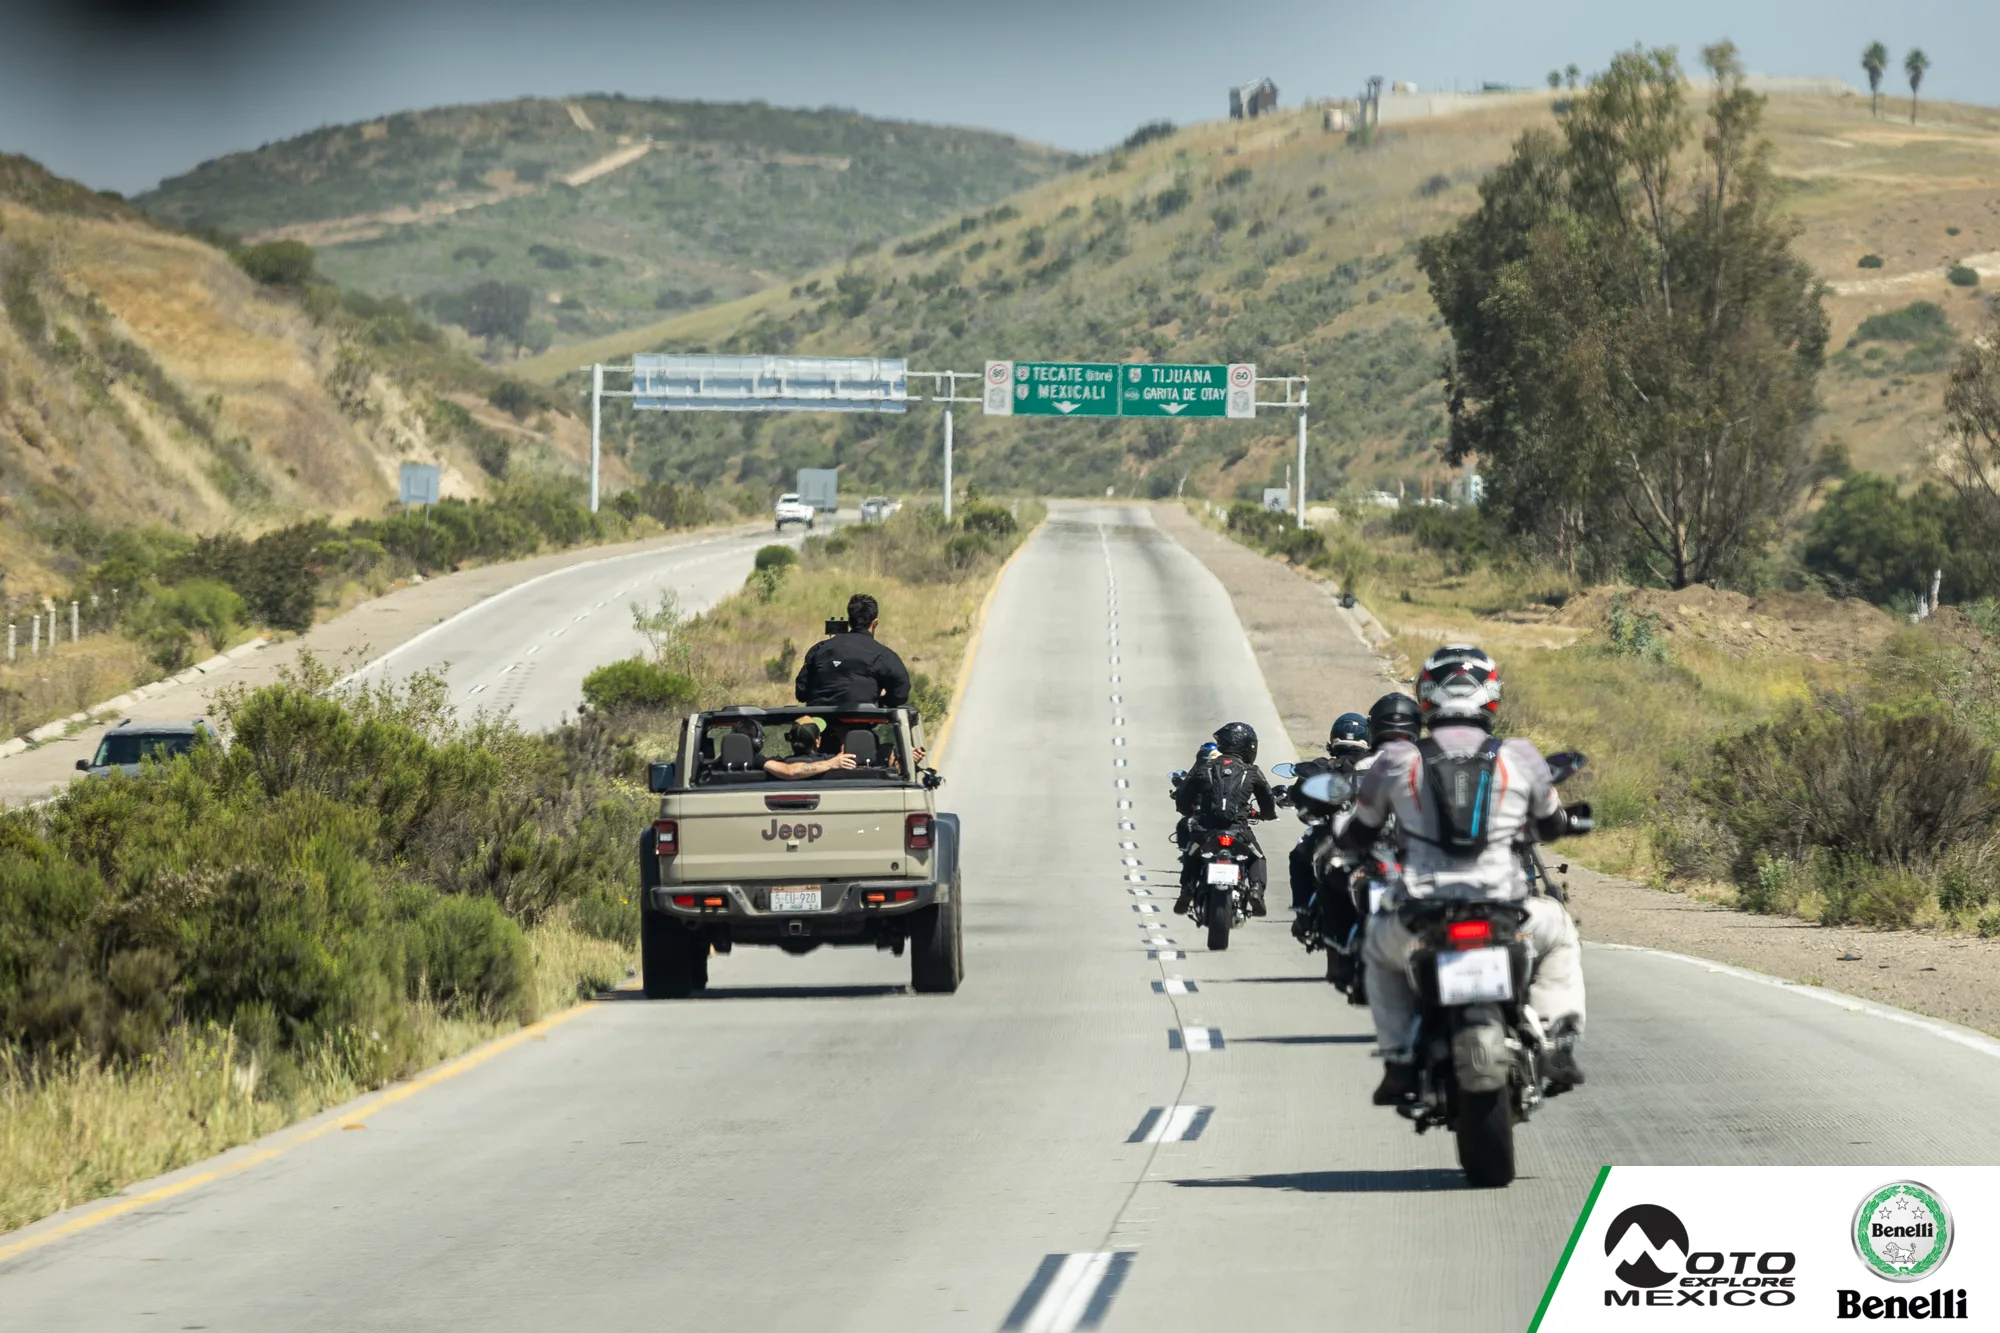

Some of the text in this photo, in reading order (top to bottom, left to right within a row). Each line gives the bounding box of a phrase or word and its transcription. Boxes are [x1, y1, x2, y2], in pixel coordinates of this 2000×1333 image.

[1033, 367, 1083, 382] TECATE
[1152, 368, 1212, 383] TIJUANA
[1038, 384, 1105, 399] MEXICALI
[1143, 387, 1179, 400] GARITA
[1183, 388, 1197, 400] DE
[1201, 387, 1226, 400] OTAY
[761, 818, 823, 843] Jeep
